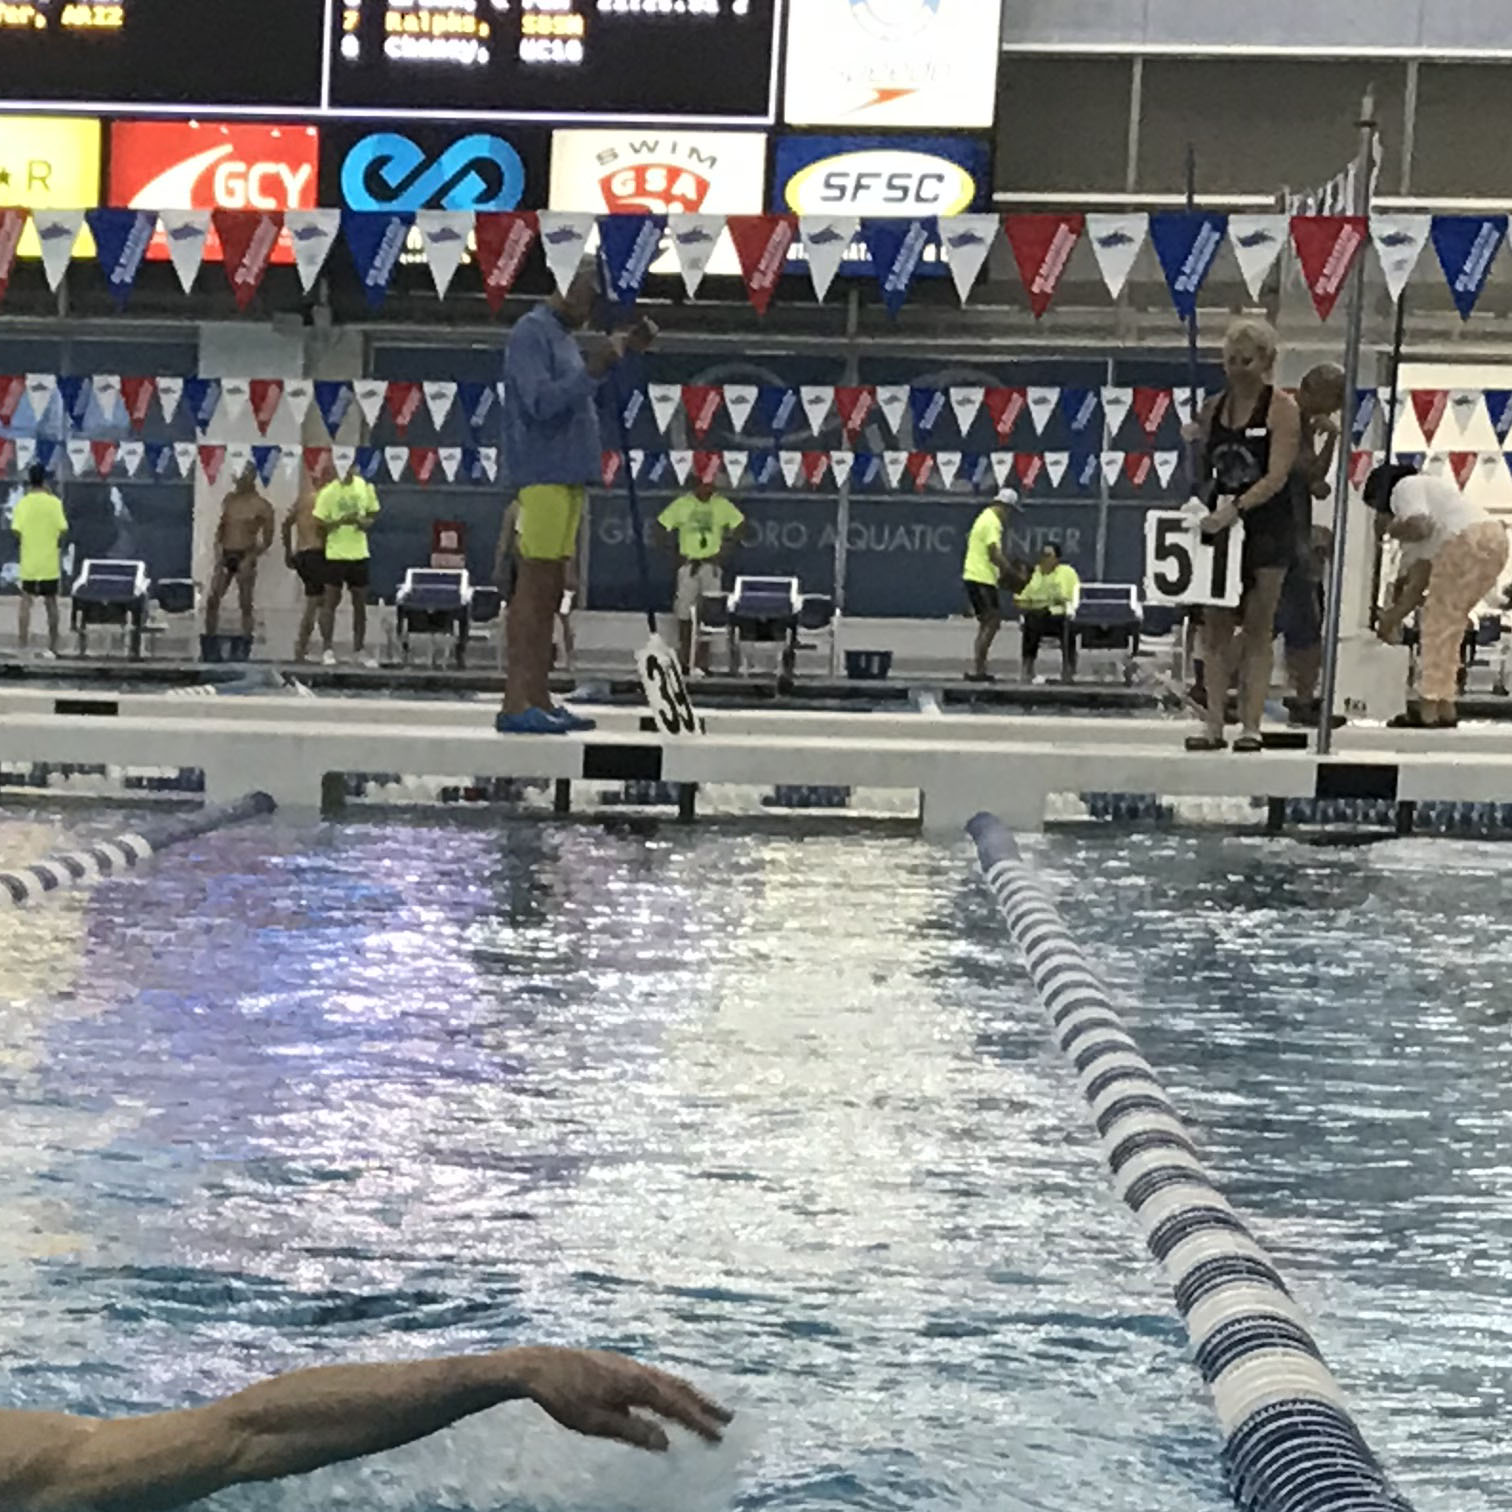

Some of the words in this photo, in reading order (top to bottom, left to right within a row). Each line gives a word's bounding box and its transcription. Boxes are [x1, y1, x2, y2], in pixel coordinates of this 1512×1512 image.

[595, 139, 718, 170] SWIM
[213, 161, 313, 210] GCY
[610, 168, 698, 201] GSA
[819, 171, 945, 203] SFSC
[1154, 518, 1232, 599] 51
